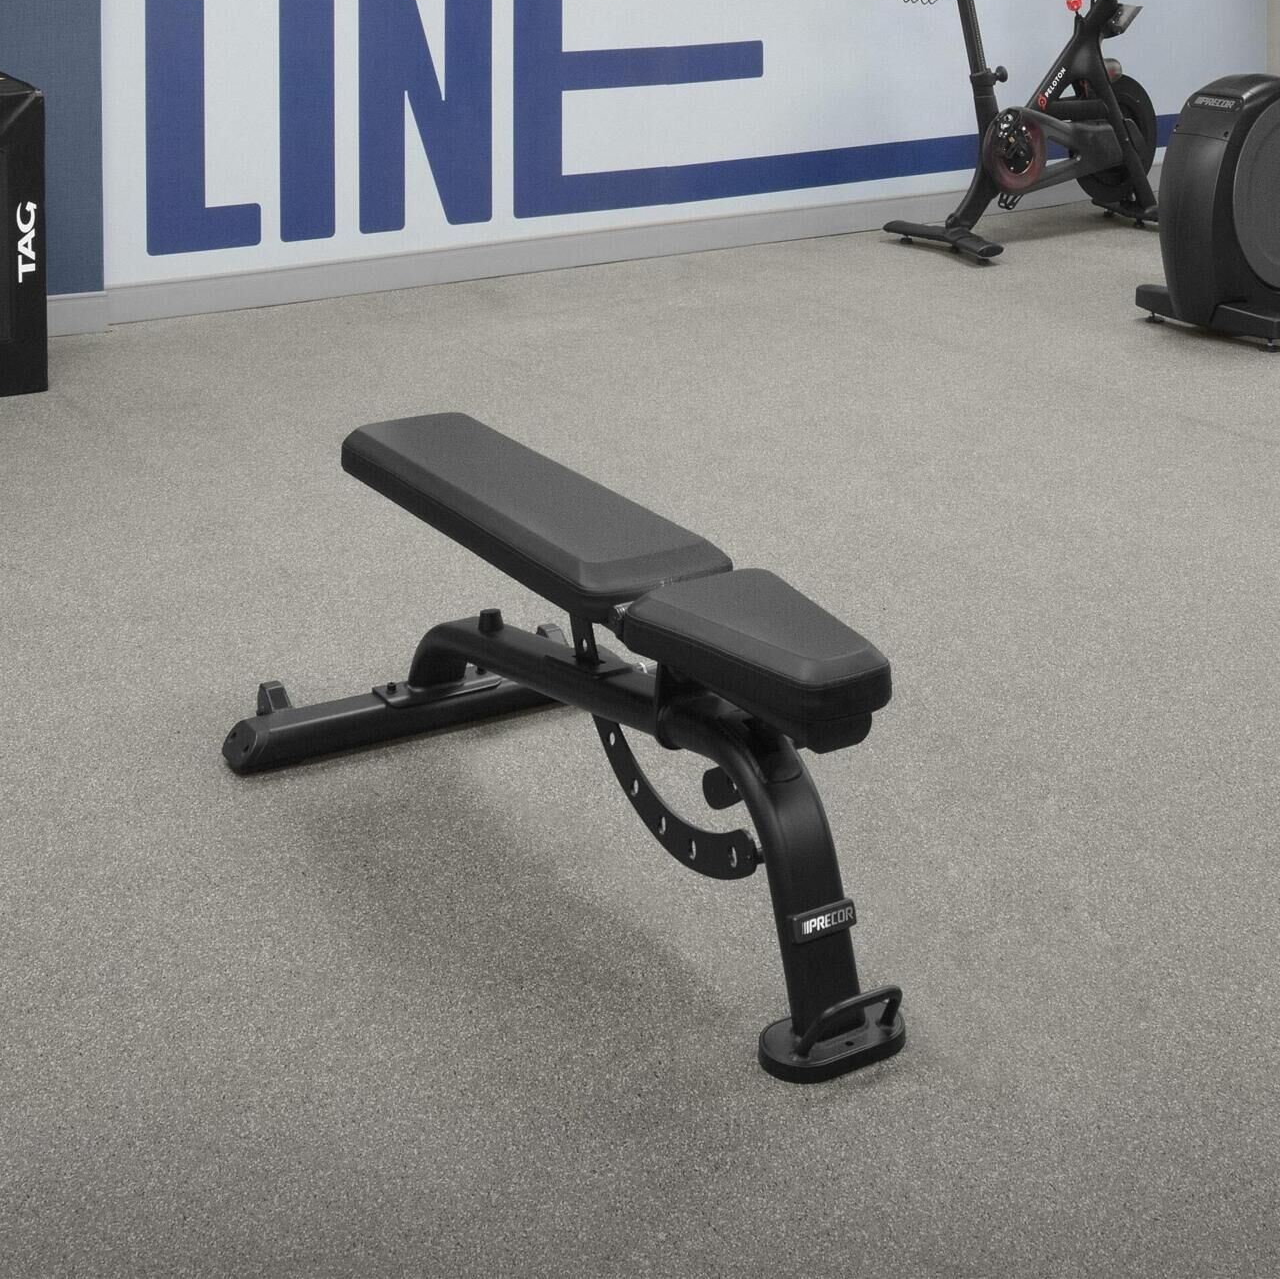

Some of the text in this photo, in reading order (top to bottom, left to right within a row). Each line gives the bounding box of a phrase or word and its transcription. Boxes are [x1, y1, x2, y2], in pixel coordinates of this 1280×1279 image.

[1044, 66, 1067, 98] PELOTON
[16, 201, 37, 283] TAG
[809, 906, 854, 934] PRECOR
